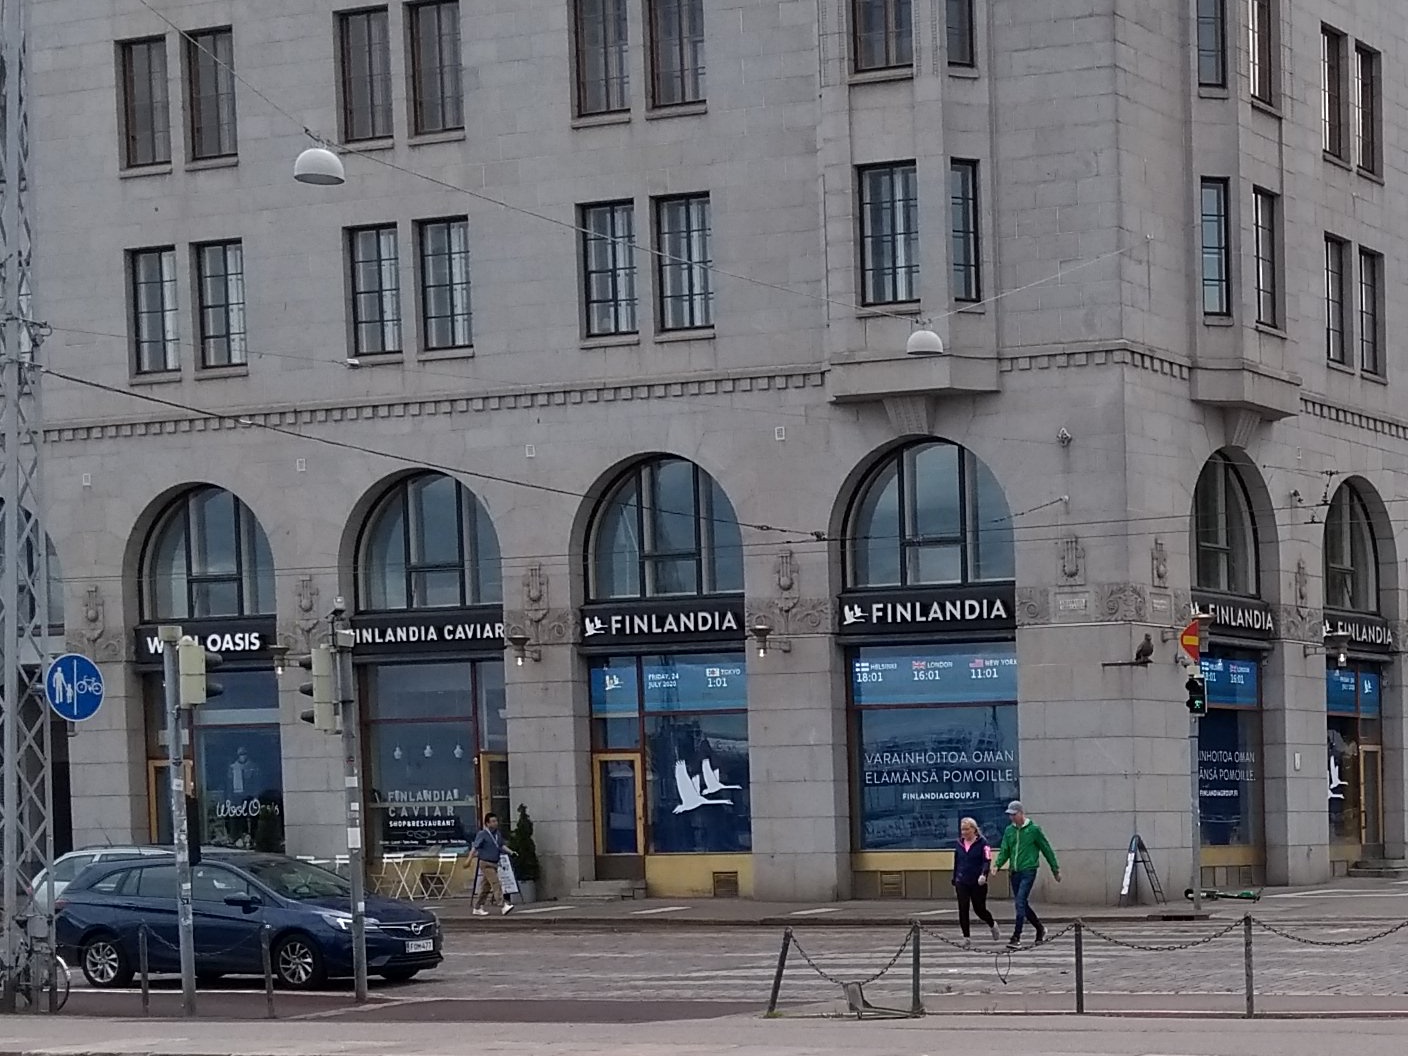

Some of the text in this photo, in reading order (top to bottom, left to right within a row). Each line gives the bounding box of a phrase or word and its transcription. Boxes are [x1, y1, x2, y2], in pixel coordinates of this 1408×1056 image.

[872, 599, 1007, 624] FINLANDIA
[611, 611, 737, 635] FINLANDIA
[350, 622, 505, 644] INLANDIA CAVIAR
[206, 632, 260, 652] OASIS
[707, 677, 727, 687] 1:01
[857, 668, 998, 682] 18:01 16:01 11:01
[865, 750, 1014, 764] VARAINHOITOA OMAN
[865, 769, 1018, 784] ELÄMÄNSÄ POMOILLE.
[902, 791, 979, 800] FINLANDIAGROUP.FI
[389, 805, 454, 817] CAVIAR
